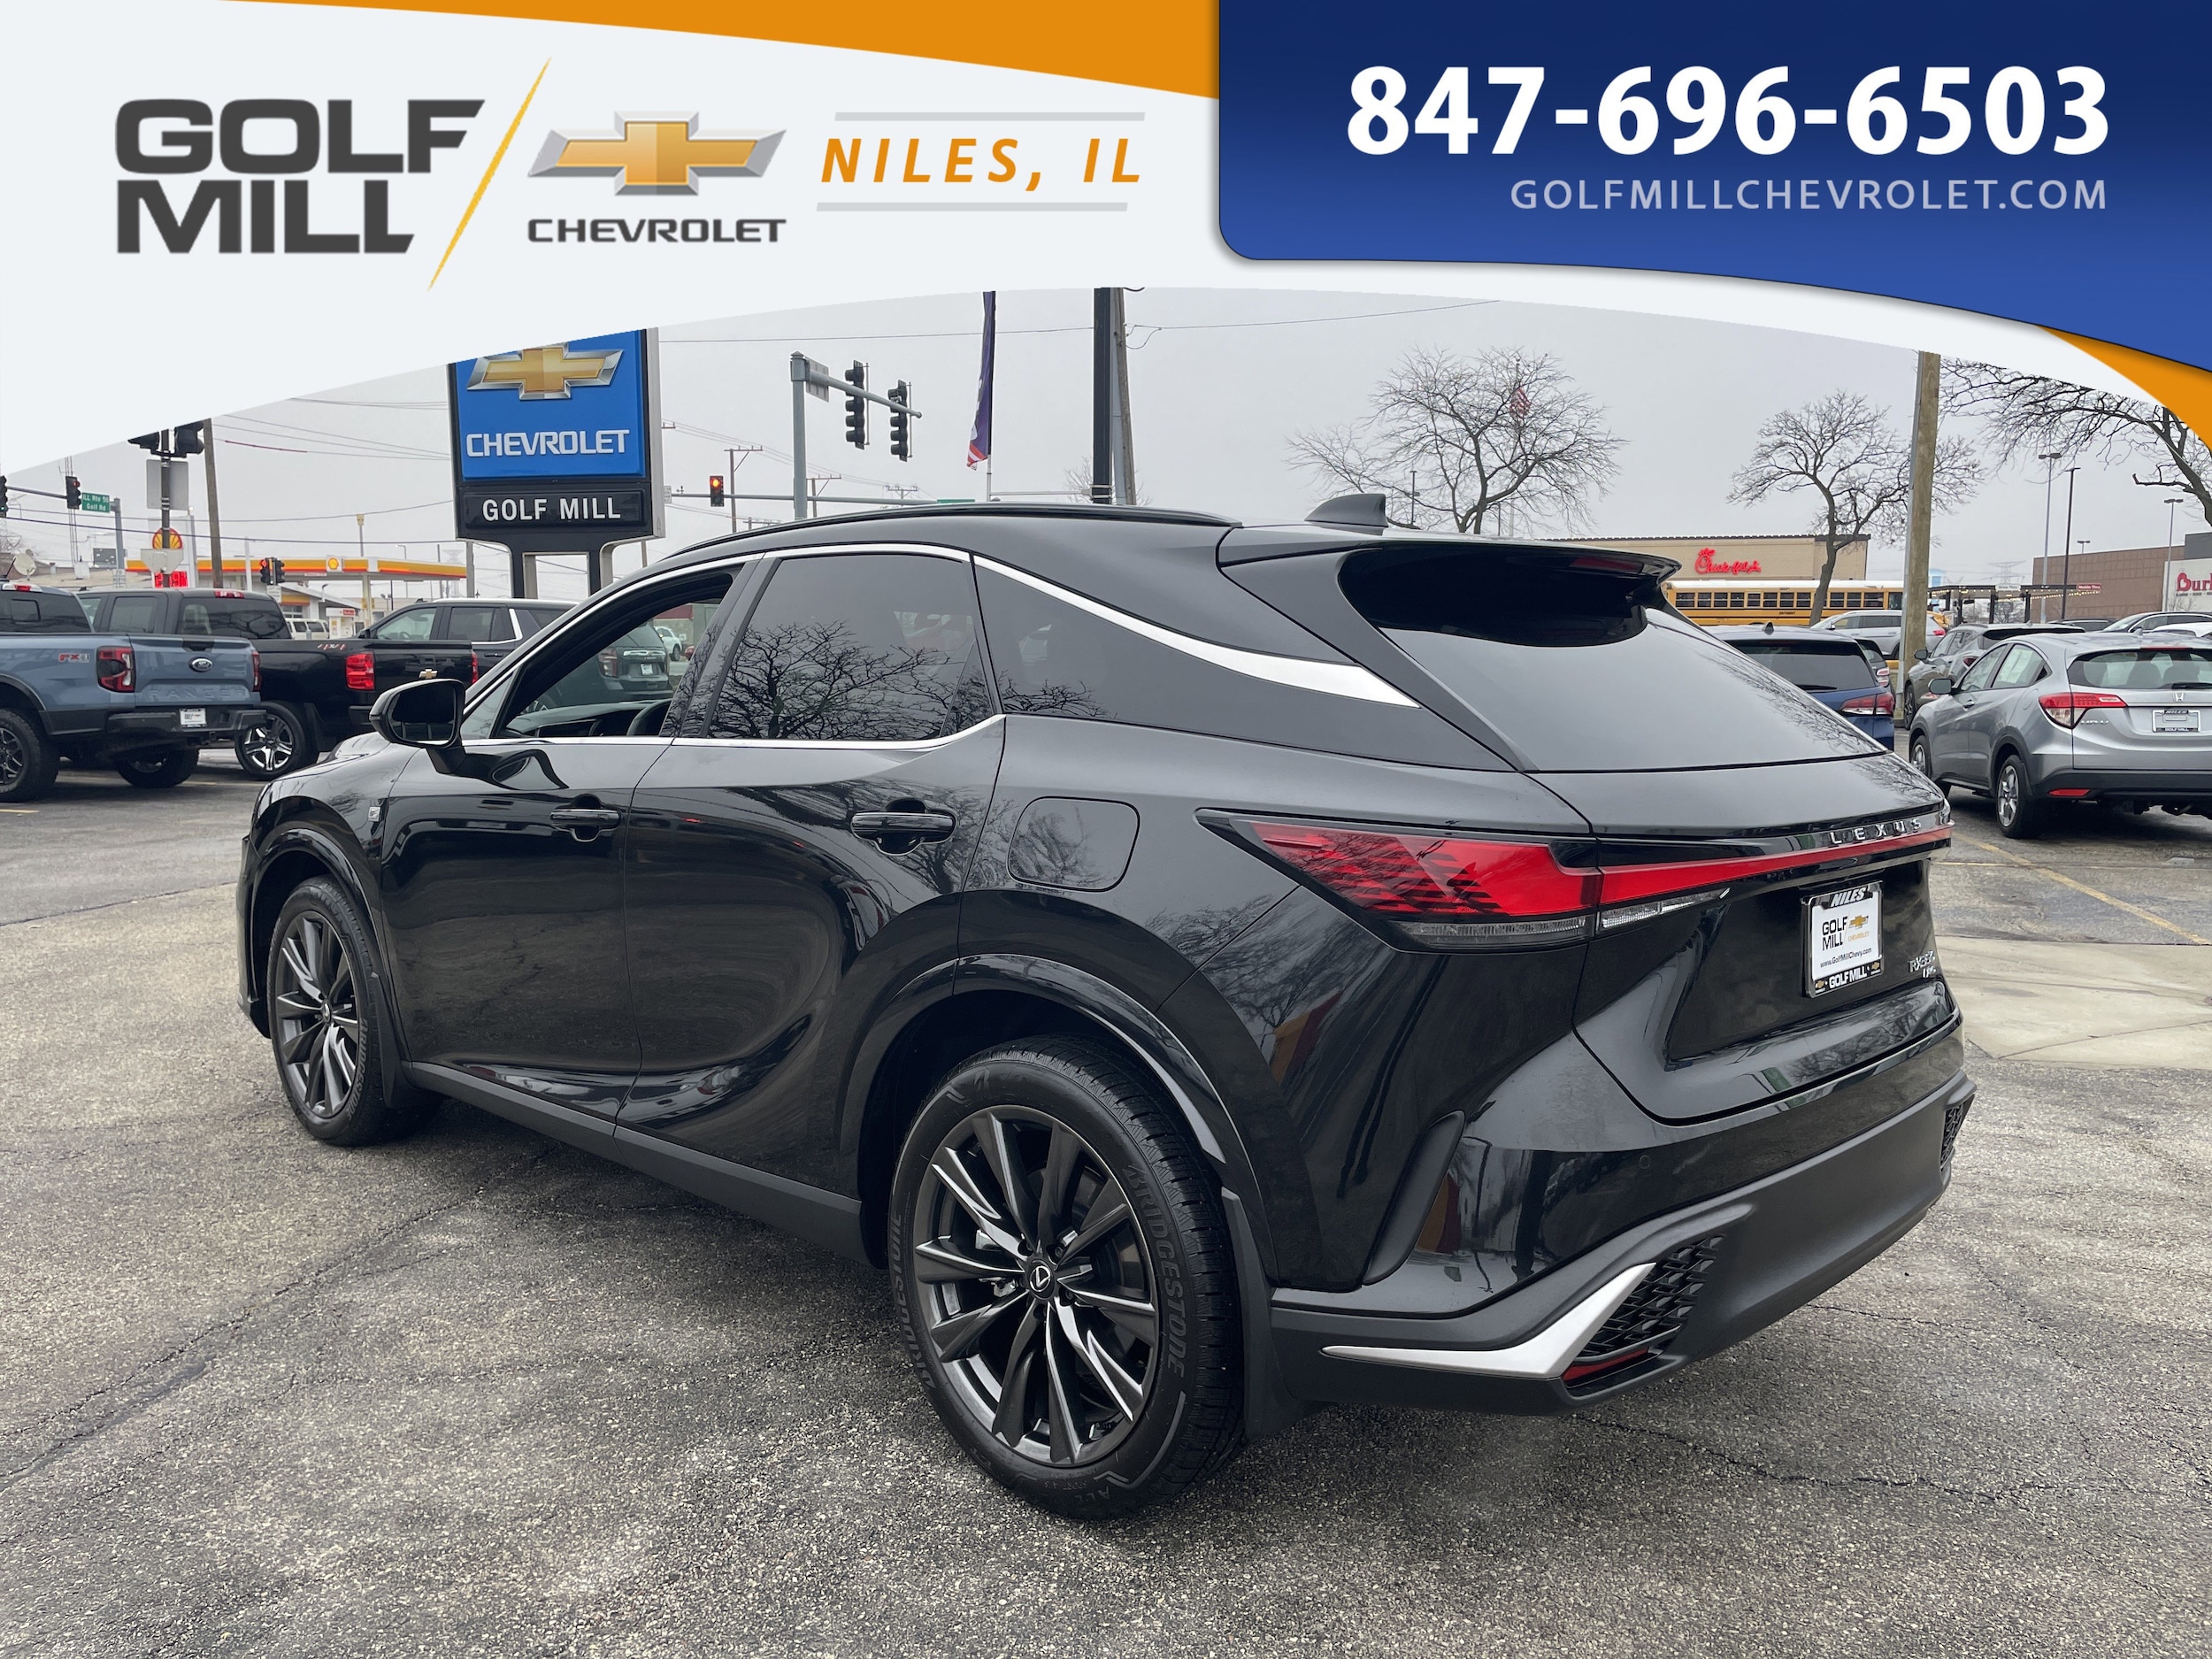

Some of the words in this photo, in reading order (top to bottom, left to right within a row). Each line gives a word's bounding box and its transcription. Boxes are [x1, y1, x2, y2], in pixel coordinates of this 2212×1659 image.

[466, 430, 630, 457] CHEVROLET
[482, 498, 548, 521] GOLF
[559, 497, 621, 519] MILL
[1829, 818, 1922, 844] LEXUS
[1831, 887, 1866, 907] NILES
[1822, 916, 1847, 935] GOLF
[1822, 932, 1844, 951] MILL
[1829, 971, 1849, 988] GOLF
[1849, 966, 1867, 982] MILL
[1122, 1164, 1187, 1379] BRIDGESTONE
